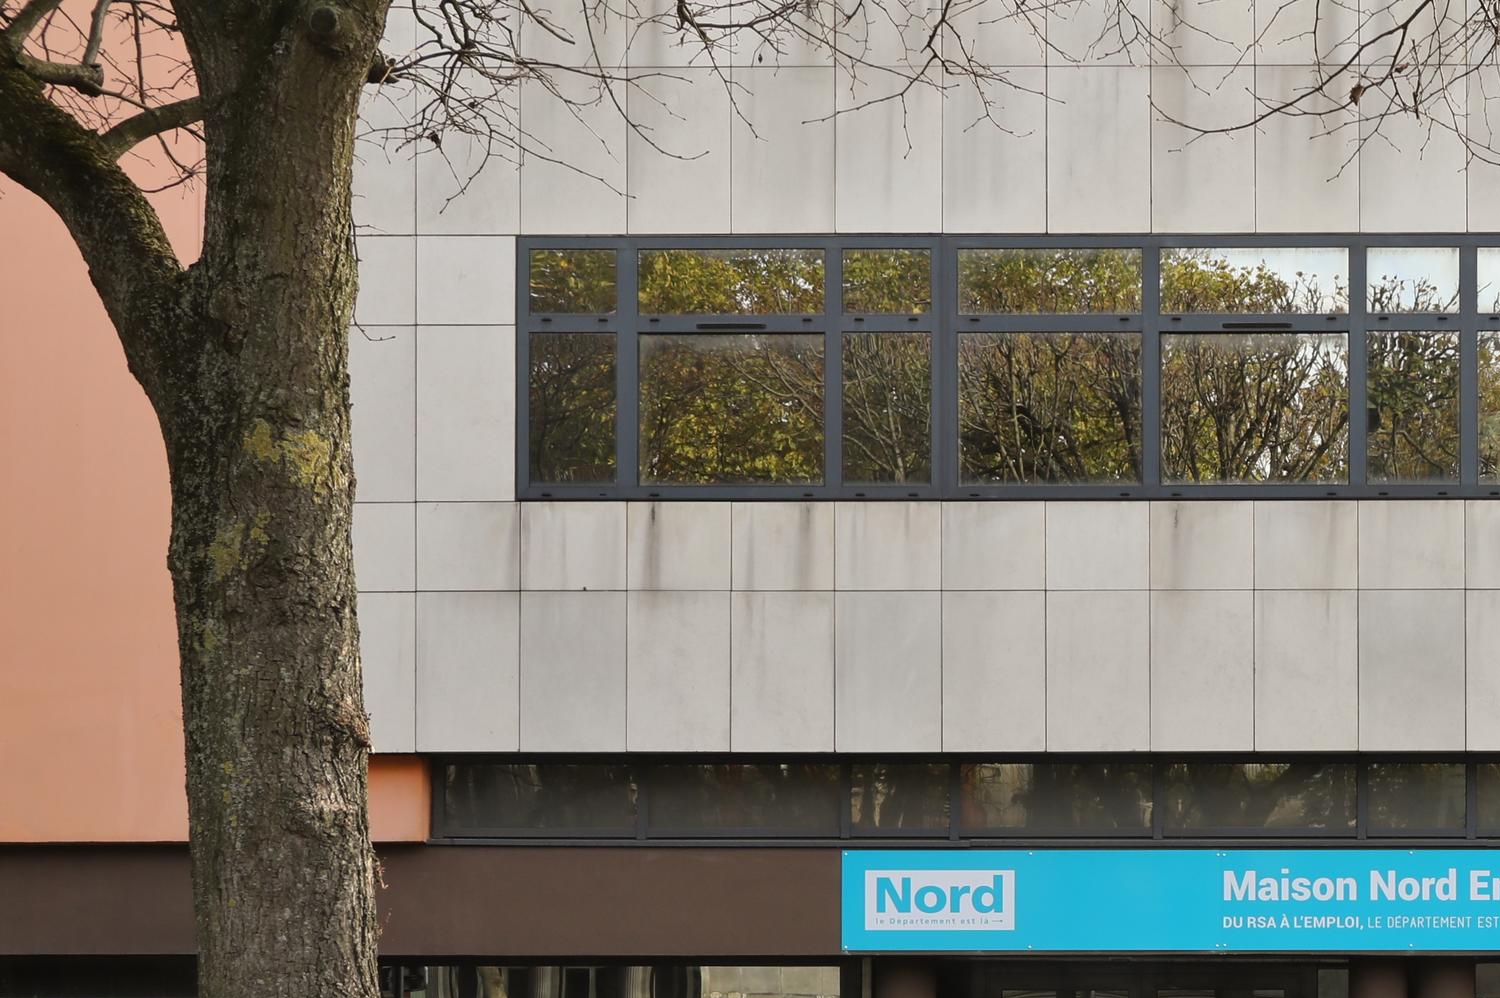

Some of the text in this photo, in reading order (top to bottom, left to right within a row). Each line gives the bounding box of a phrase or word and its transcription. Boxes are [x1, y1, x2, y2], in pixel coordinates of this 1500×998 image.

[876, 874, 1003, 913] Nord
[1223, 868, 1358, 901] Maison
[1370, 868, 1457, 901] Nord
[1223, 916, 1243, 928] DU
[1247, 916, 1277, 928] RSA
[1279, 913, 1293, 928] À
[1294, 915, 1364, 930] L'EMPLOI,
[1367, 916, 1382, 928] LE
[1387, 913, 1472, 928] DÉPARTEMENT
[1477, 916, 1500, 928] EST
